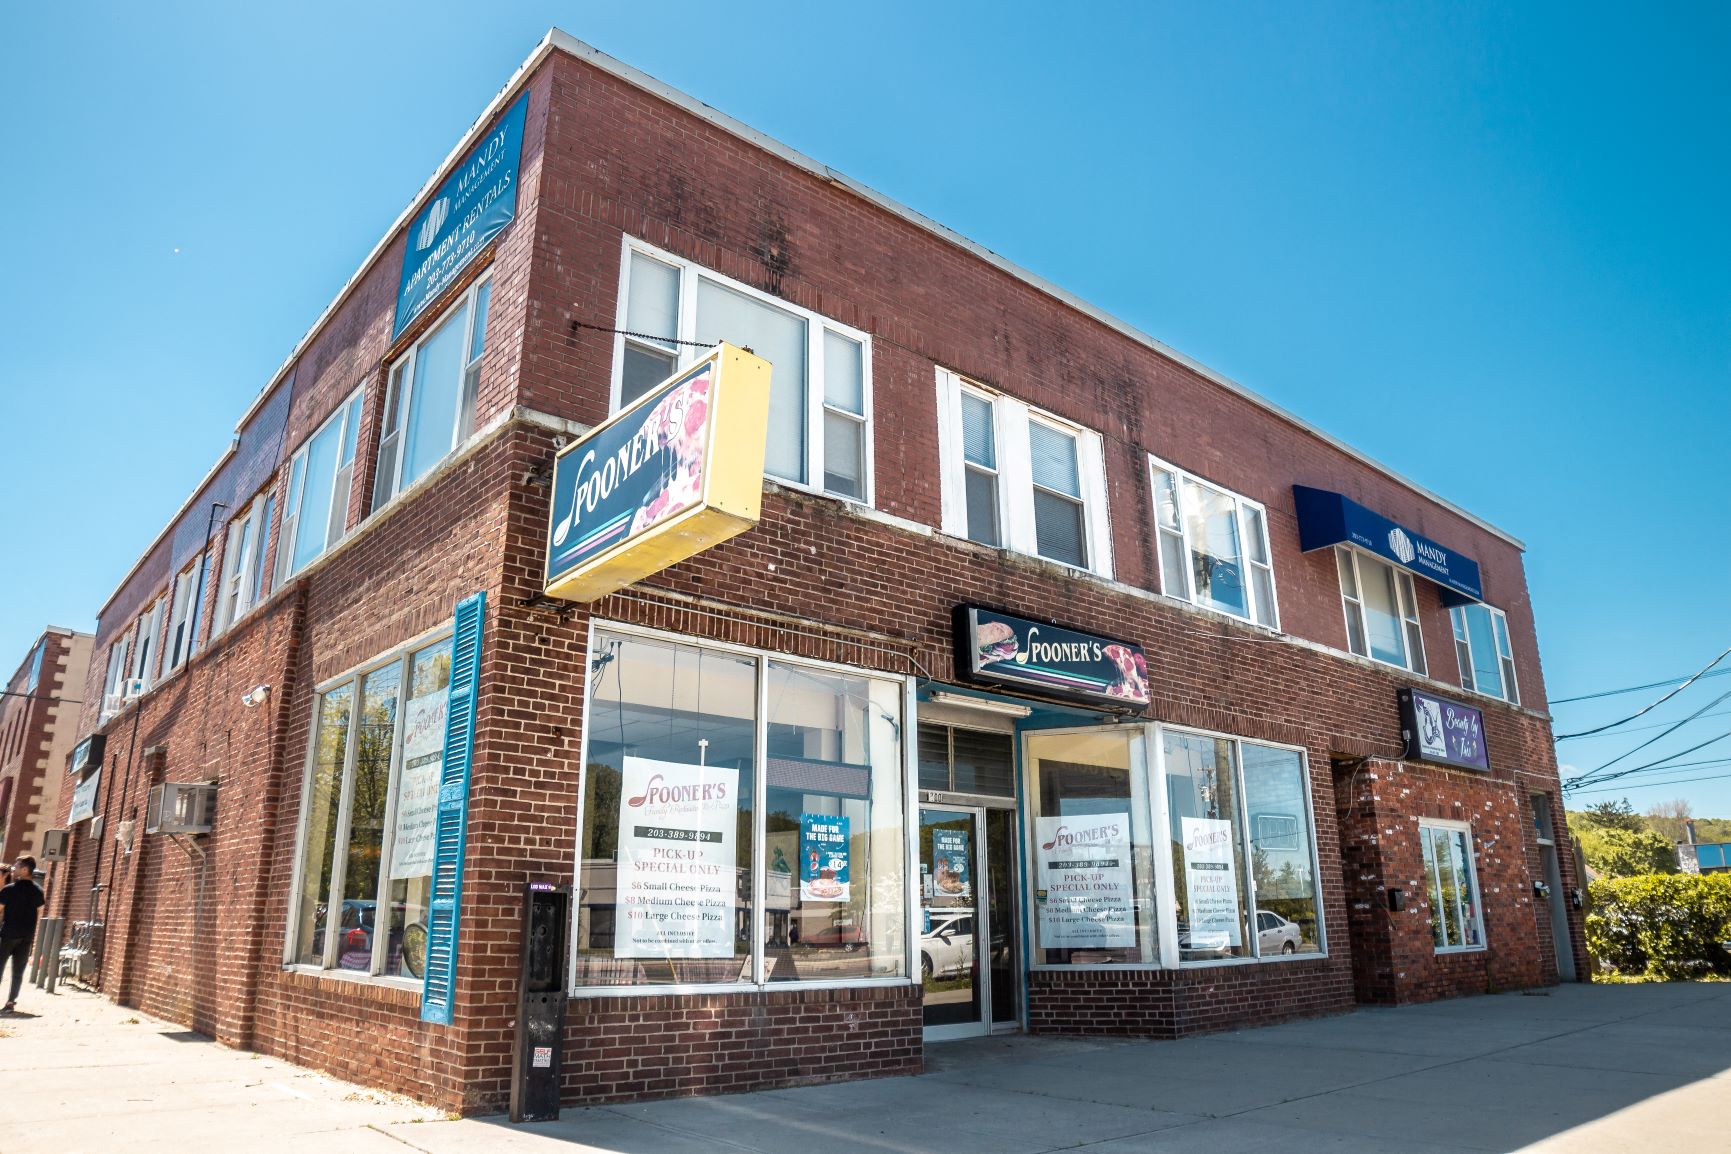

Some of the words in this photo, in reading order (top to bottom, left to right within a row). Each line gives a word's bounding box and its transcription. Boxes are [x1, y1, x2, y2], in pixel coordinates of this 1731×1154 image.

[456, 124, 509, 197] MANDY
[453, 148, 508, 214] MANAGEMENT
[403, 223, 462, 297] APARTMENT
[462, 169, 511, 233] RENTALS
[1416, 540, 1447, 566] MANDY
[1418, 555, 1449, 576] MANAGEMENT
[1015, 627, 1102, 665] SPOONER'S
[628, 774, 726, 807] SPOONER'S
[806, 832, 817, 840] THE
[817, 833, 828, 841] BIG
[829, 834, 845, 842] GAME
[811, 824, 828, 833] MADE
[828, 825, 839, 833] FOR
[1043, 826, 1119, 850] SPOONER'S
[1187, 828, 1228, 850] SPOONER'S
[634, 861, 686, 874] SPECIAL
[689, 864, 720, 875] ONLY
[631, 882, 641, 890] $6
[643, 882, 667, 890] Small
[1064, 873, 1104, 882] PICK-UP
[1050, 884, 1091, 892] SPECIAL
[1093, 883, 1119, 891] ONLY
[1194, 885, 1215, 893] SPECIAL
[637, 896, 672, 905] Medium
[674, 897, 703, 906] Cheee
[705, 898, 726, 907] Pizza
[627, 911, 643, 919] $10
[645, 911, 669, 922] Large
